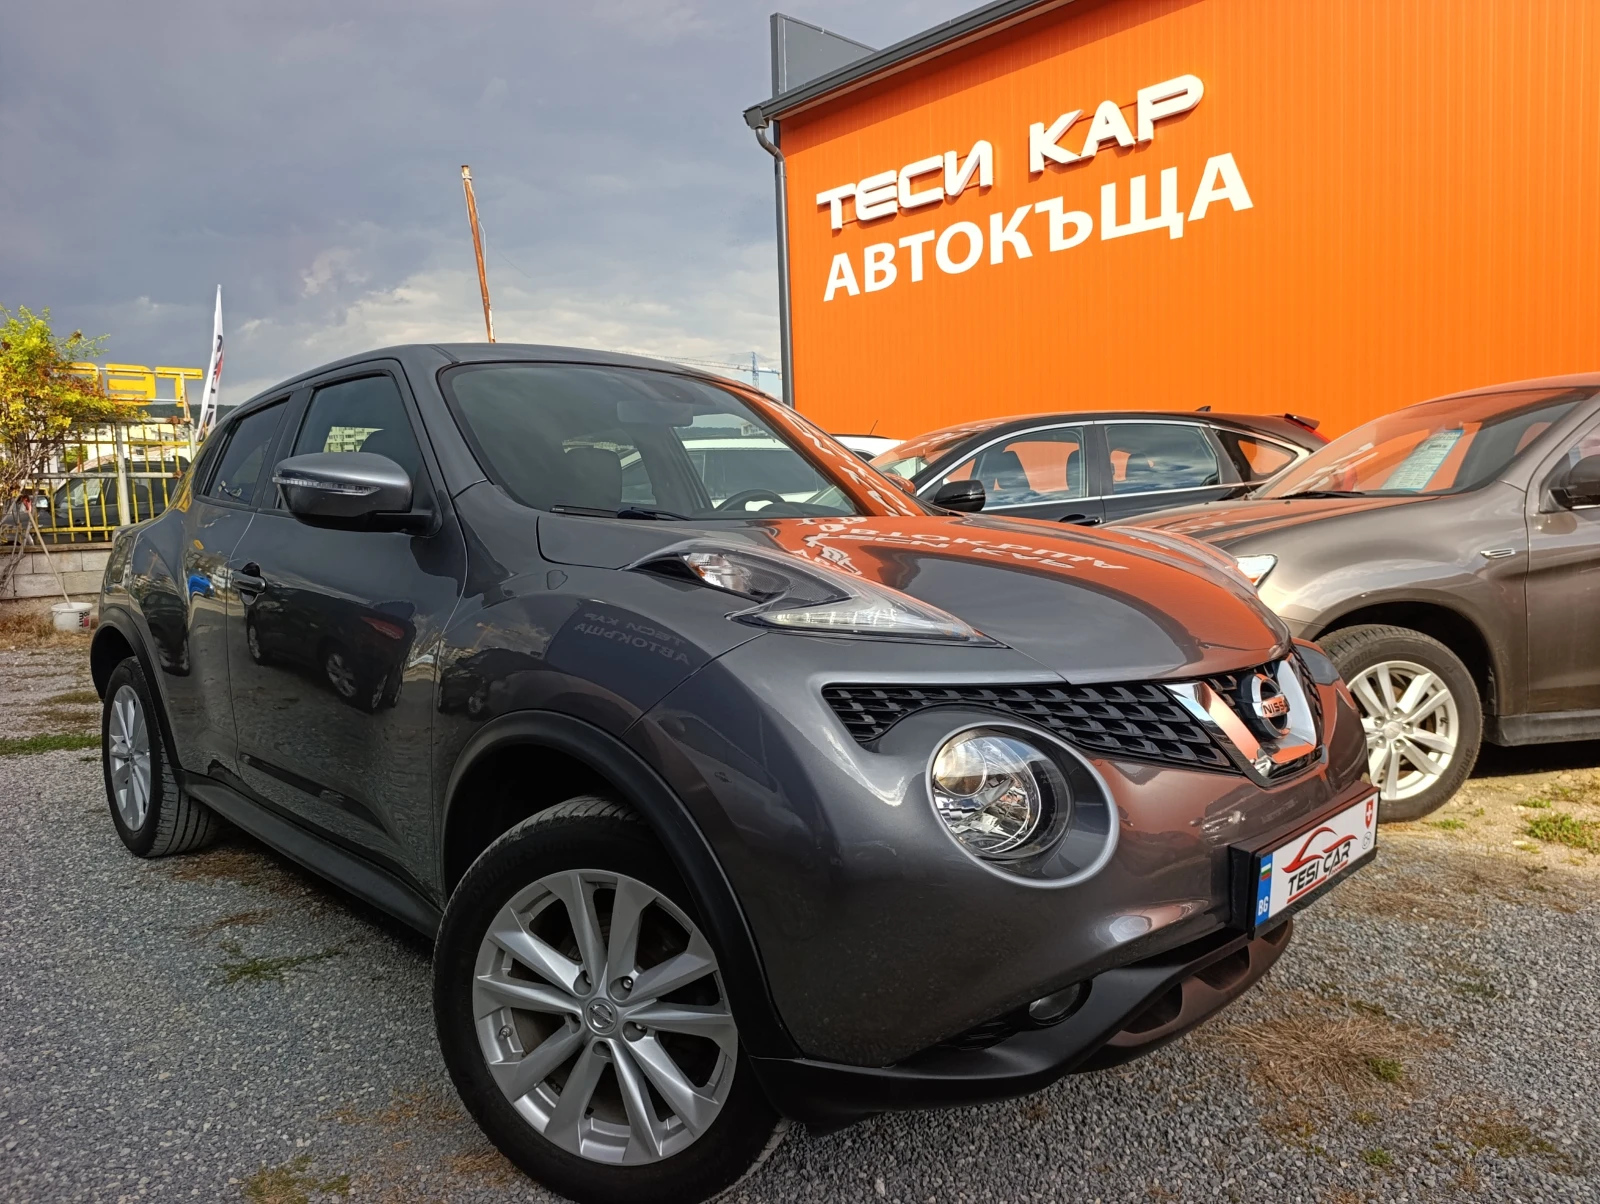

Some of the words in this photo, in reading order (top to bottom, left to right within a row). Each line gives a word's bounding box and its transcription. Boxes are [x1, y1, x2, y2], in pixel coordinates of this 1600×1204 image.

[816, 139, 994, 231] ТЕСИ
[1028, 73, 1205, 173] КАР
[822, 152, 1254, 302] АВТОКЪЩА
[1262, 700, 1288, 715] NISS
[1288, 860, 1320, 896] TESI
[1323, 841, 1351, 875] CAR
[1258, 896, 1269, 916] BG
